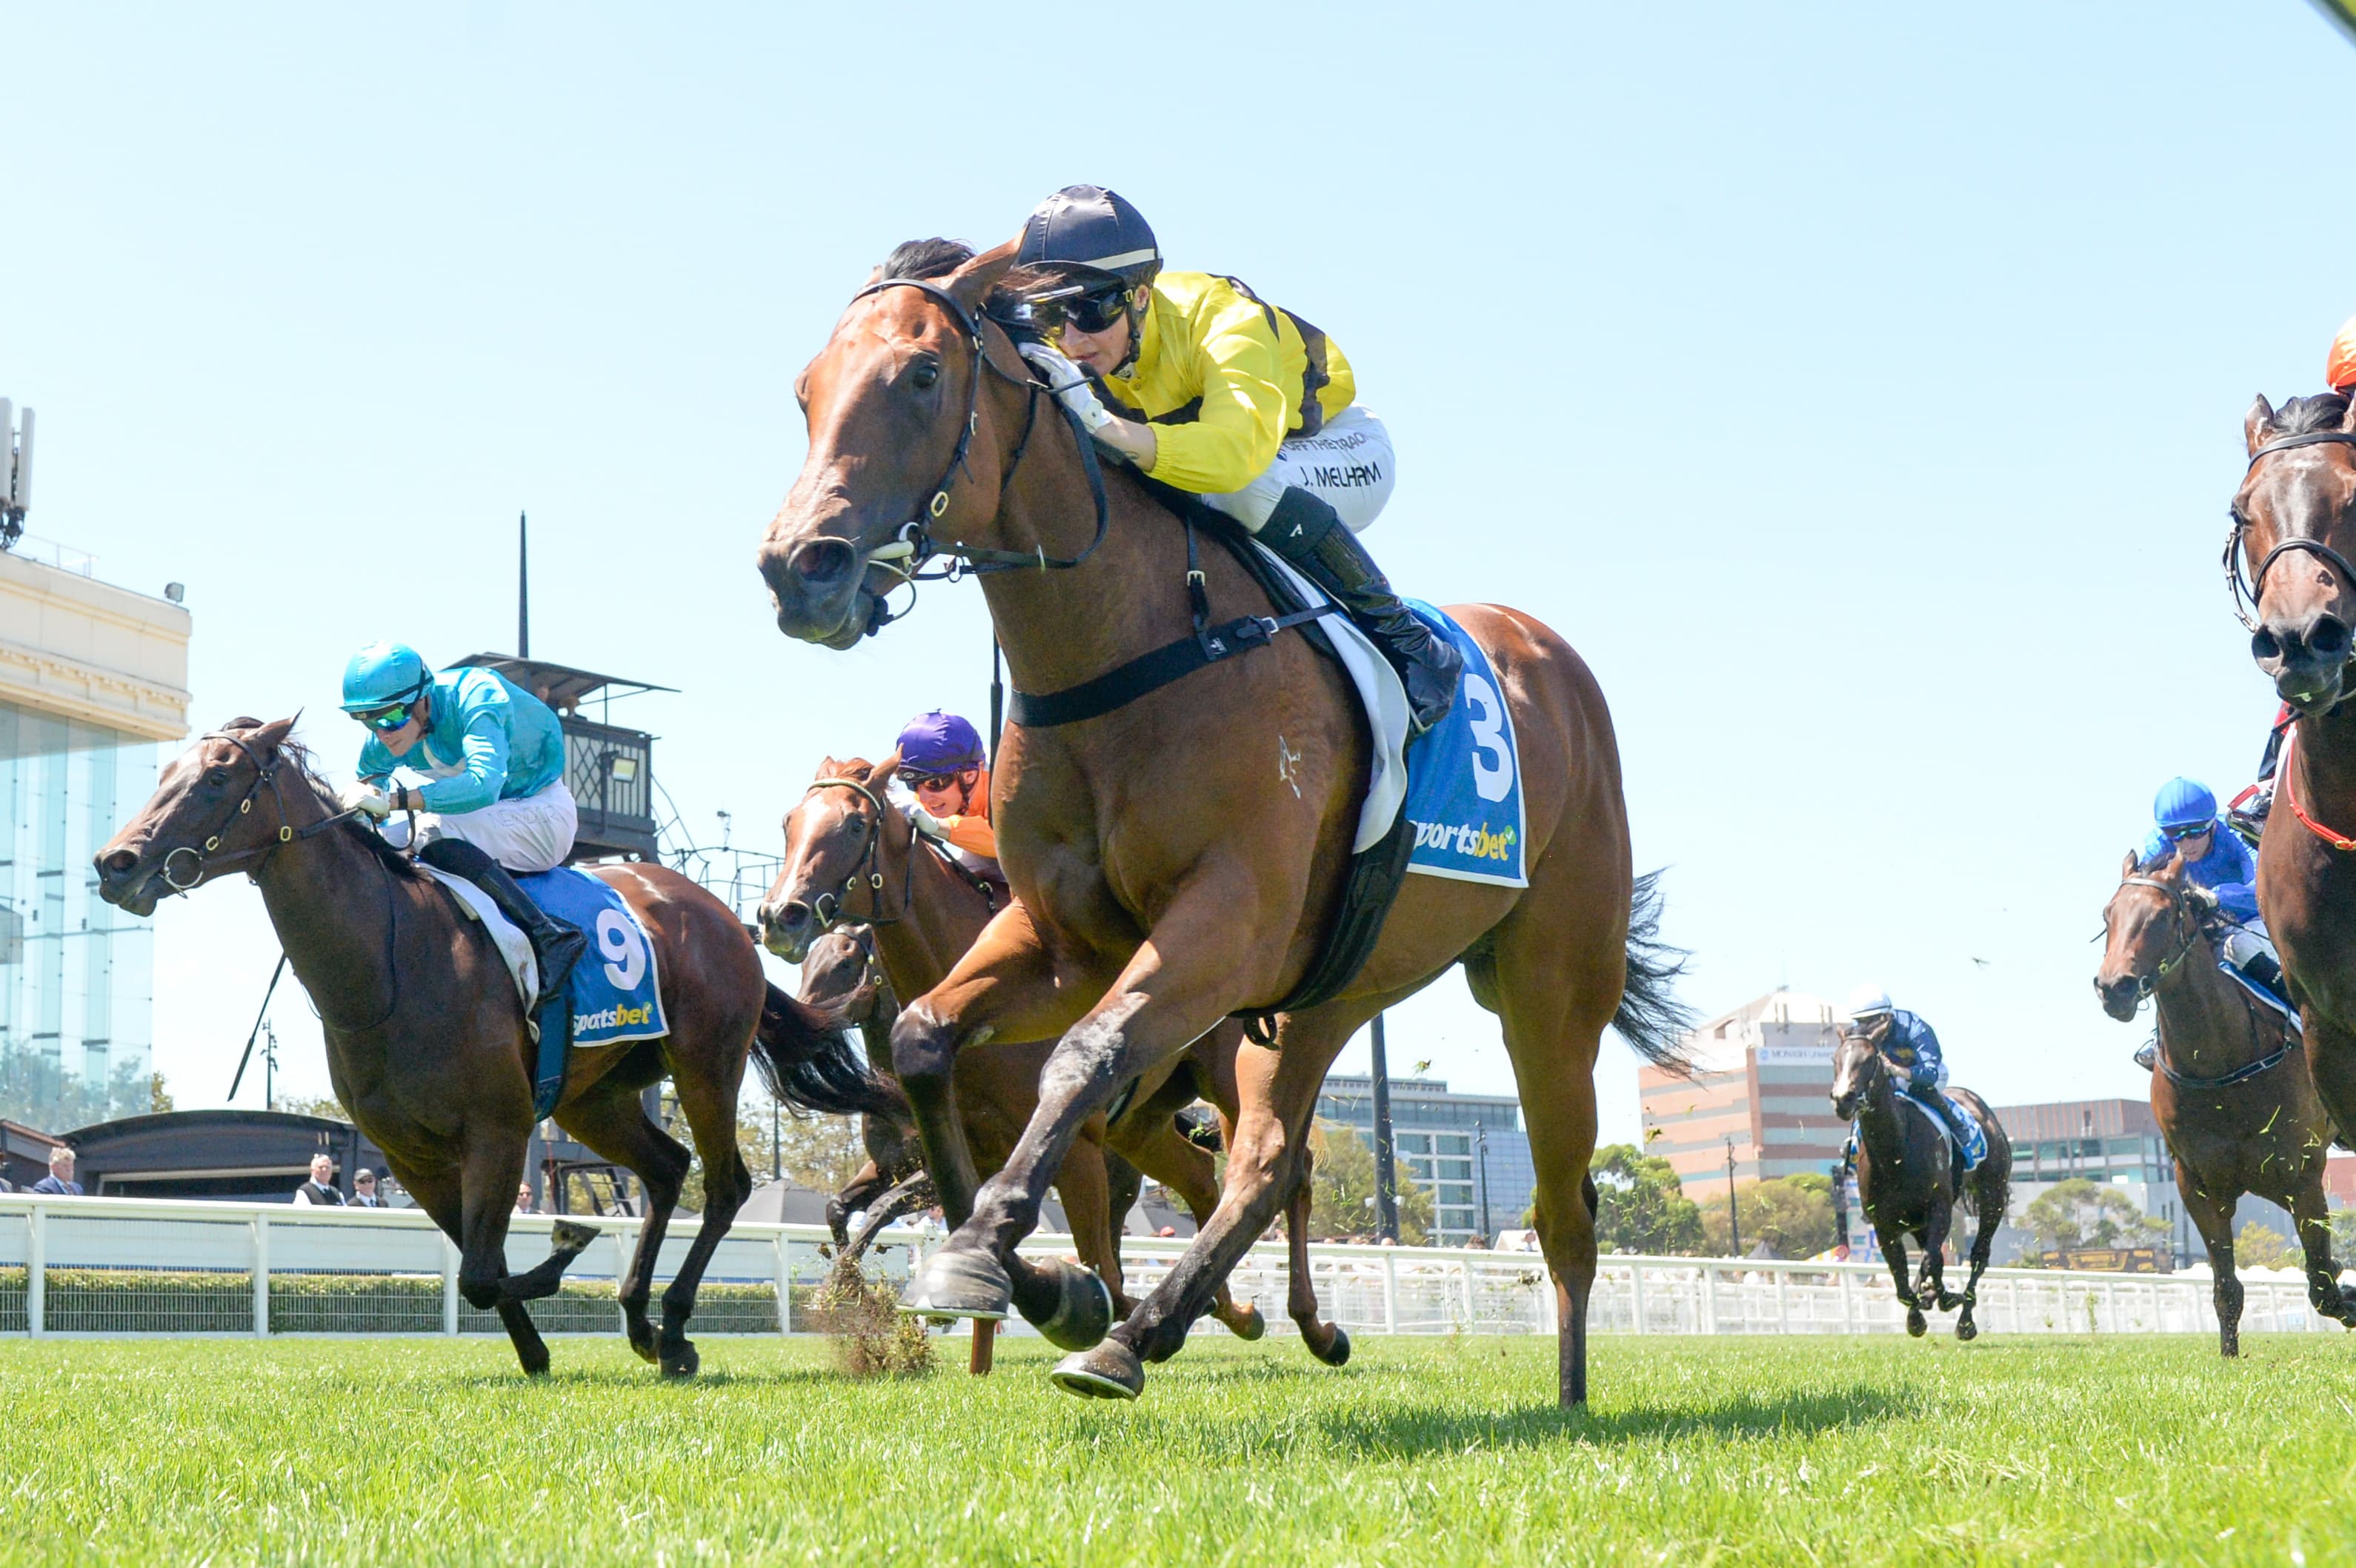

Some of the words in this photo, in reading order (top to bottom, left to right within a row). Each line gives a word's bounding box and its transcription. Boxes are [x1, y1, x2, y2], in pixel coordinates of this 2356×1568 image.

[1305, 439, 1338, 451] THE
[1331, 432, 1368, 450] TRAC
[1300, 466, 1314, 486] J.
[1315, 461, 1382, 488] MELHAM
[1463, 673, 1514, 803] 3
[1408, 820, 1509, 861] portsbet
[596, 908, 647, 991] 9
[573, 1002, 650, 1037] spotsbet
